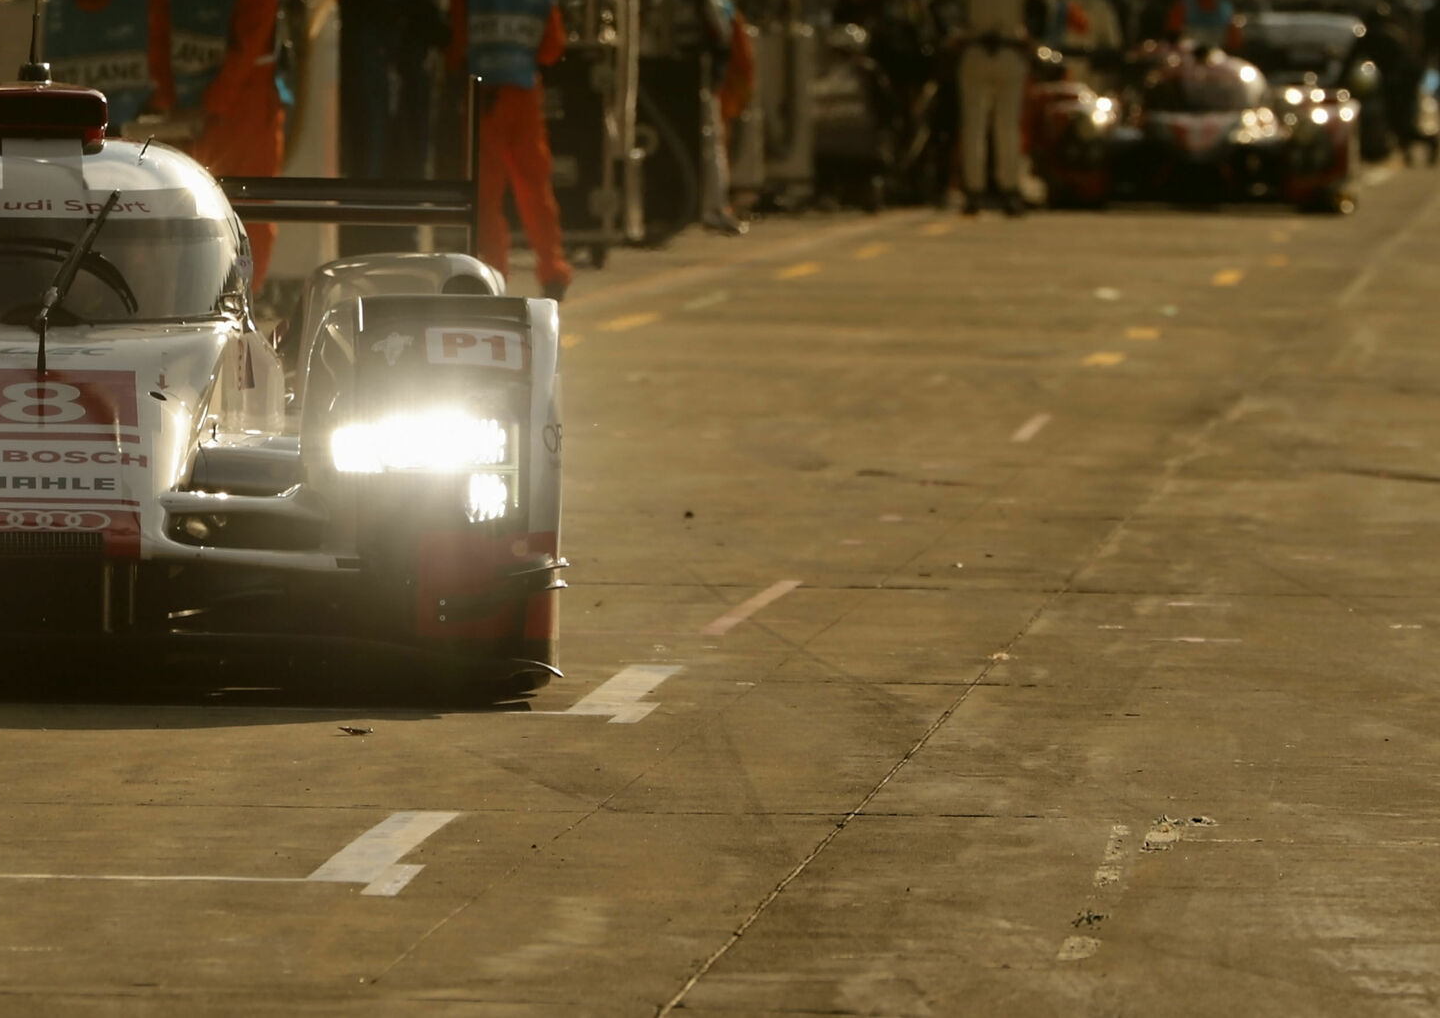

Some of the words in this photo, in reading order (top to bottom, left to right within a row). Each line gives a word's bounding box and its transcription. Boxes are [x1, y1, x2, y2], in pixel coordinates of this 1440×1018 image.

[65, 199, 150, 215] Sport
[442, 333, 507, 362] P1
[3, 450, 148, 468] BOSCH
